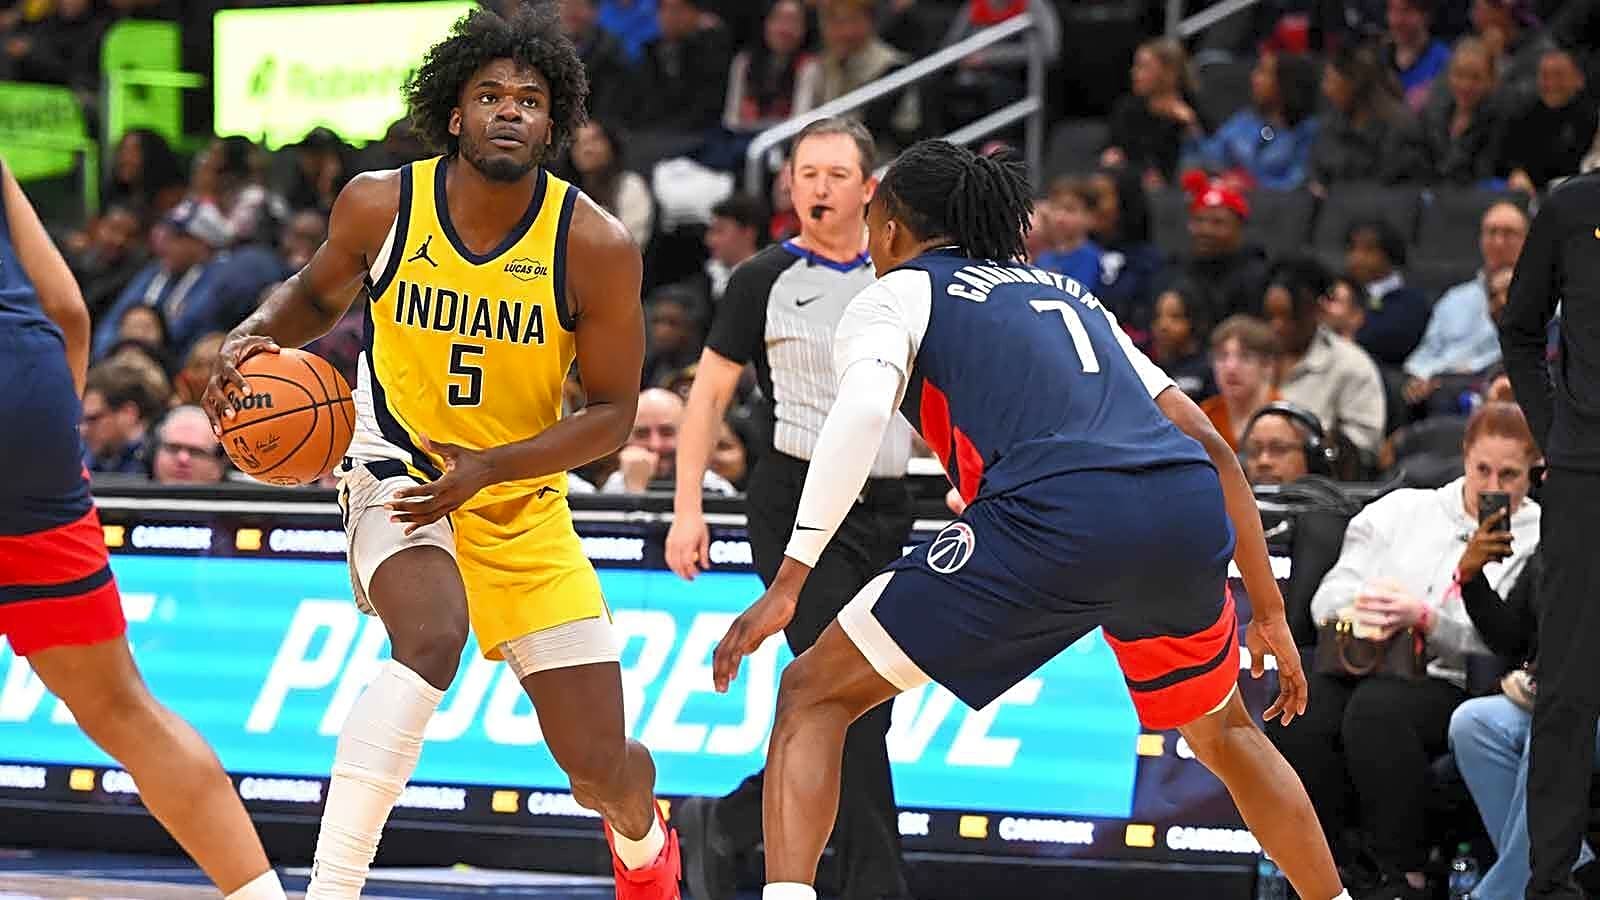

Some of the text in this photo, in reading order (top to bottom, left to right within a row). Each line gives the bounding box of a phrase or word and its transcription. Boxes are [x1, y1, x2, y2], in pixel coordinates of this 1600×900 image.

[504, 263, 547, 276] LUCAS OIL
[395, 280, 545, 344] INDIANA
[1029, 300, 1100, 373] 7
[448, 343, 484, 407] 5
